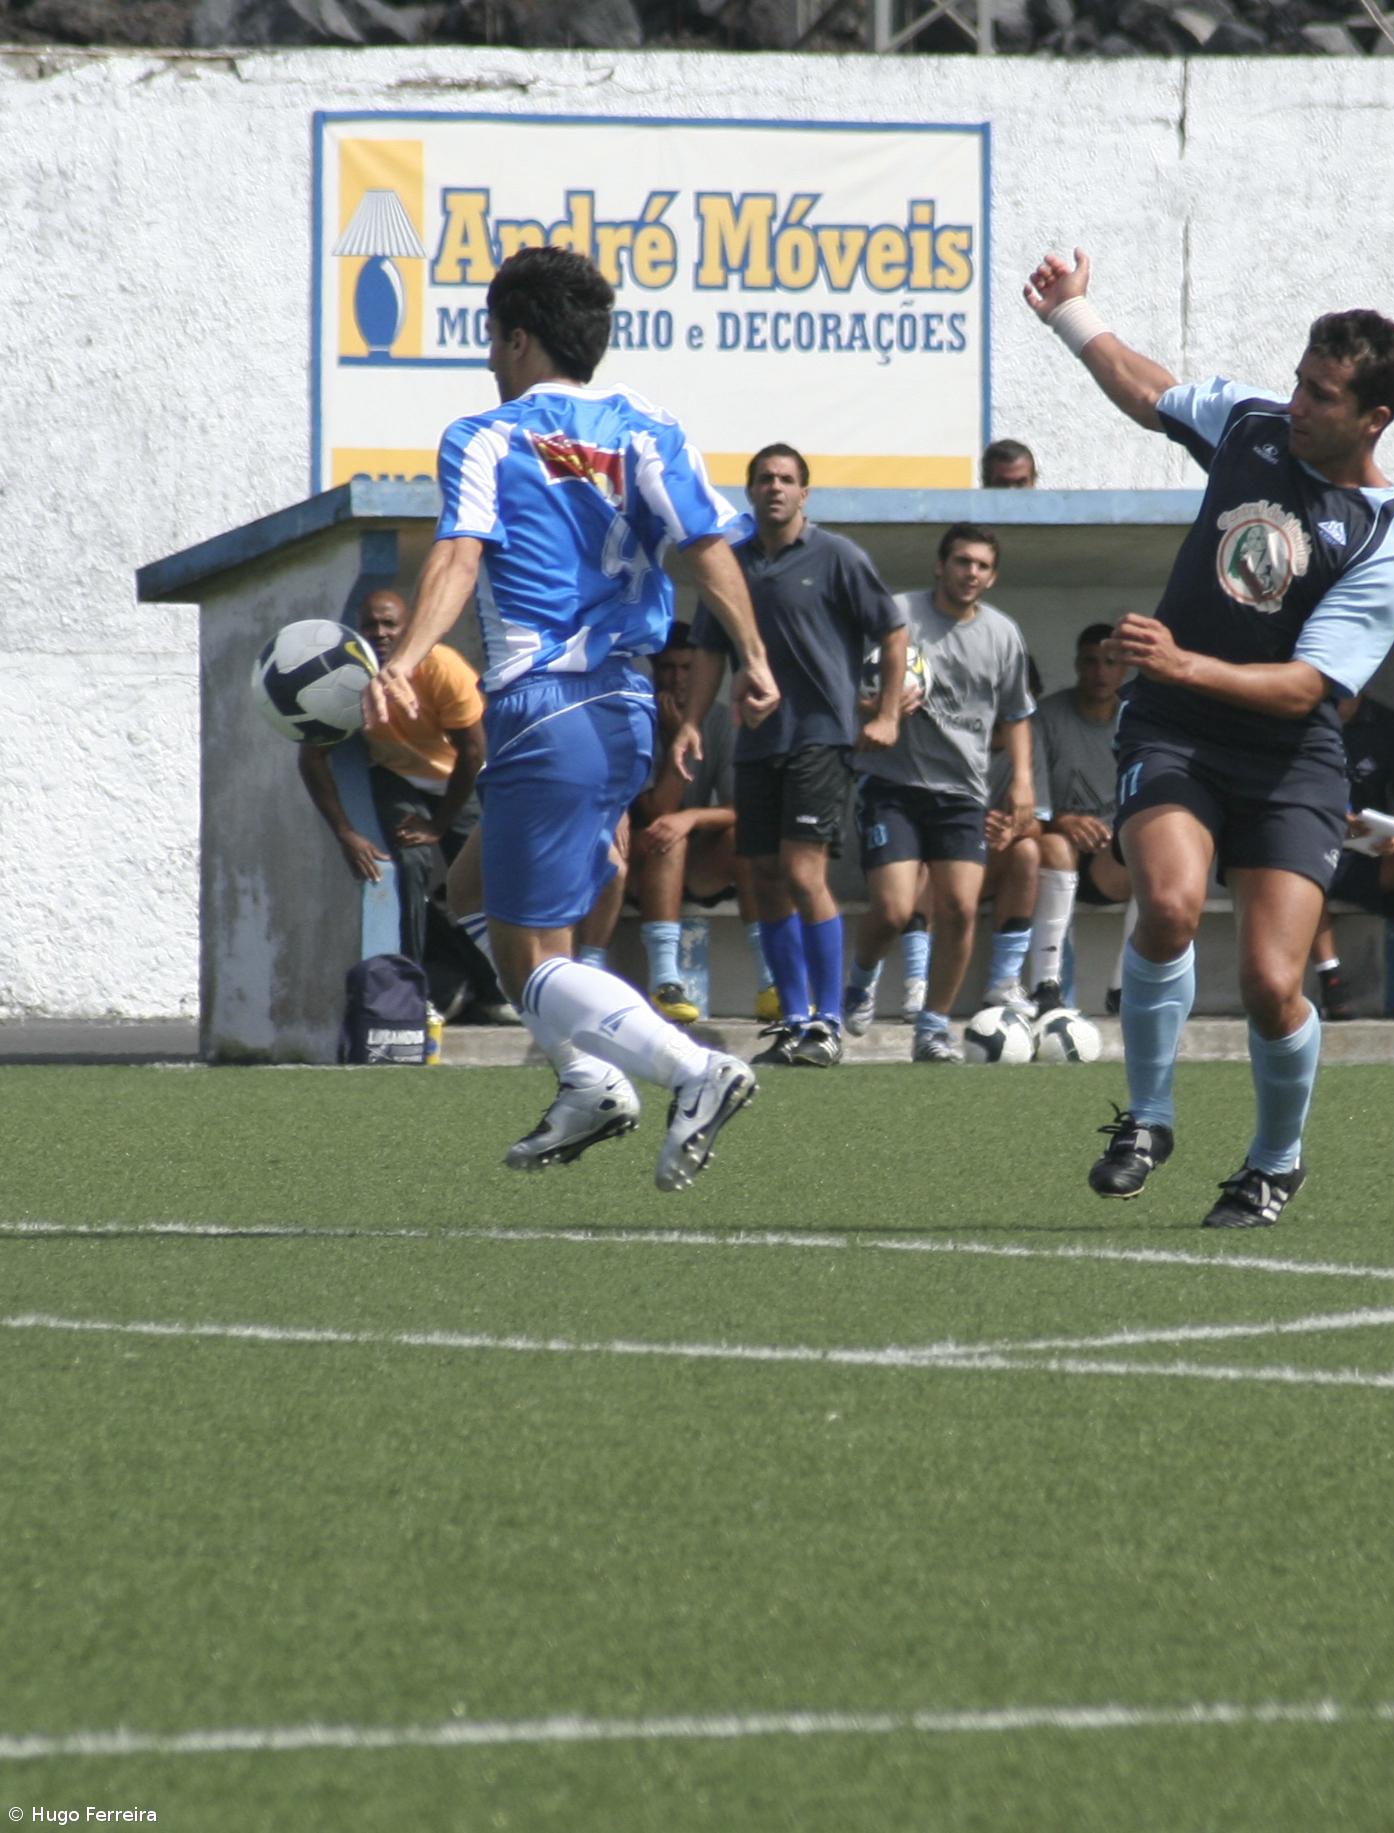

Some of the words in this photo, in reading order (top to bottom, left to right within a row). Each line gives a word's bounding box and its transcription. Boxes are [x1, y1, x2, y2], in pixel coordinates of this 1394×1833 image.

[431, 187, 679, 290] André
[693, 190, 974, 292] Móveis
[686, 323, 704, 349] e
[717, 300, 967, 365] DECORAÇÕES
